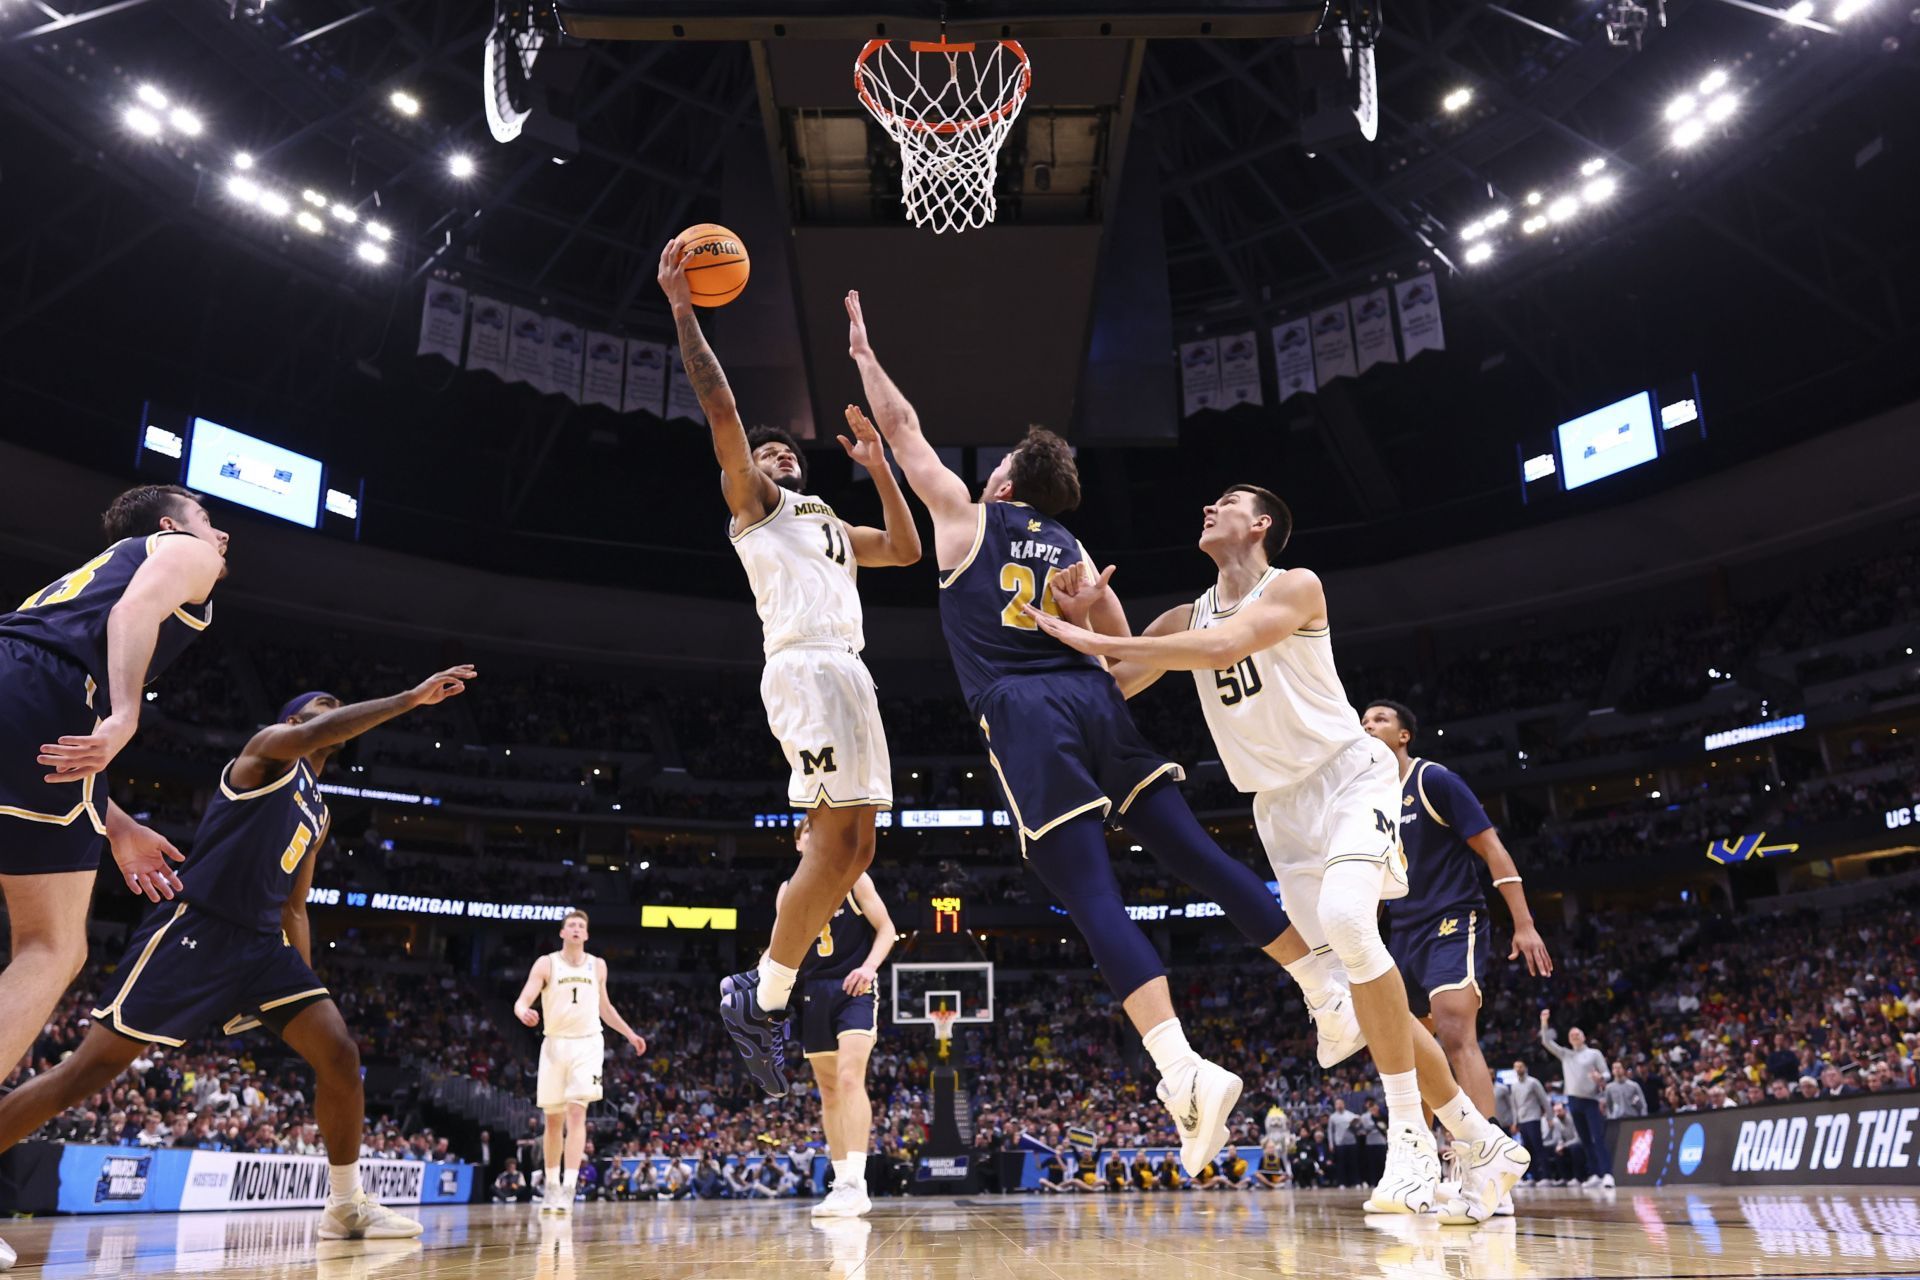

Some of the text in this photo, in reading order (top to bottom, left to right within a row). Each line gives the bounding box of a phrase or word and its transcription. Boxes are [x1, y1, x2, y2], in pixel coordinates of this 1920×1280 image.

[794, 502, 837, 517] MICHI
[821, 522, 847, 566] 11
[1010, 539, 1063, 566] KAPIC
[1214, 654, 1263, 707] 50
[798, 746, 838, 776] M
[1885, 807, 1911, 829] UC
[280, 821, 313, 875] 5
[346, 892, 368, 907] VS
[371, 893, 465, 916] MICHIGAN
[936, 909, 958, 934] 17
[557, 977, 593, 986] MICHIGAN
[571, 987, 579, 1004] 1
[1731, 1107, 1919, 1172] ROAD TO THE
[229, 1161, 314, 1201] MOUNTAIN
